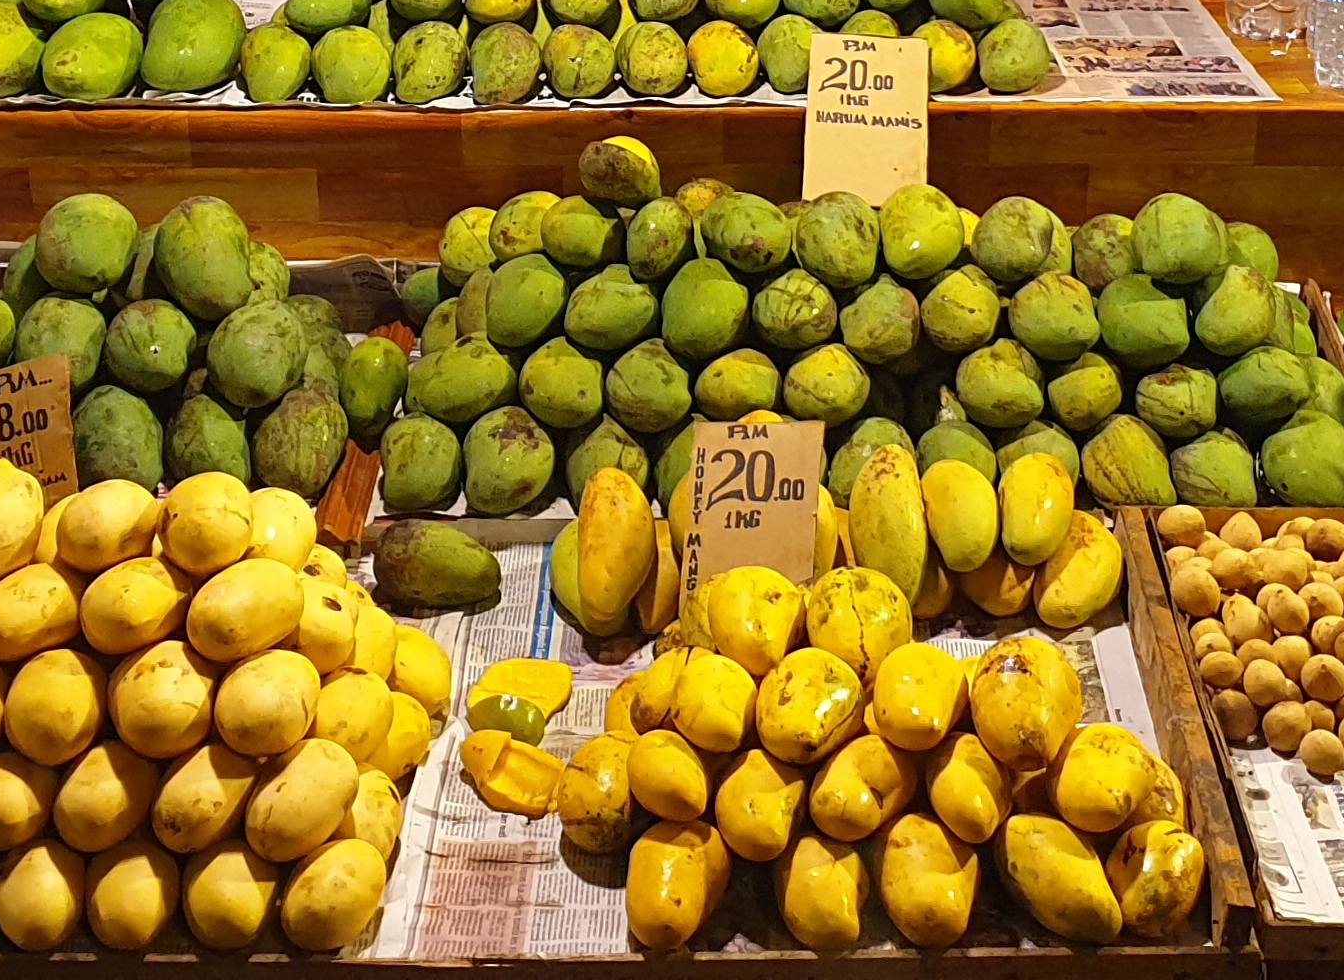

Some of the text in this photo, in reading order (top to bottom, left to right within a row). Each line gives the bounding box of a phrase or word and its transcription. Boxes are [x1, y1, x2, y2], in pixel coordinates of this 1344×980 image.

[842, 39, 877, 52] RM
[817, 56, 894, 93] 20.00
[816, 109, 923, 130] HARUM MANIS
[727, 424, 769, 440] RM
[692, 447, 706, 525] HONEY
[705, 448, 805, 511] 20.00
[686, 532, 702, 592] MANG
